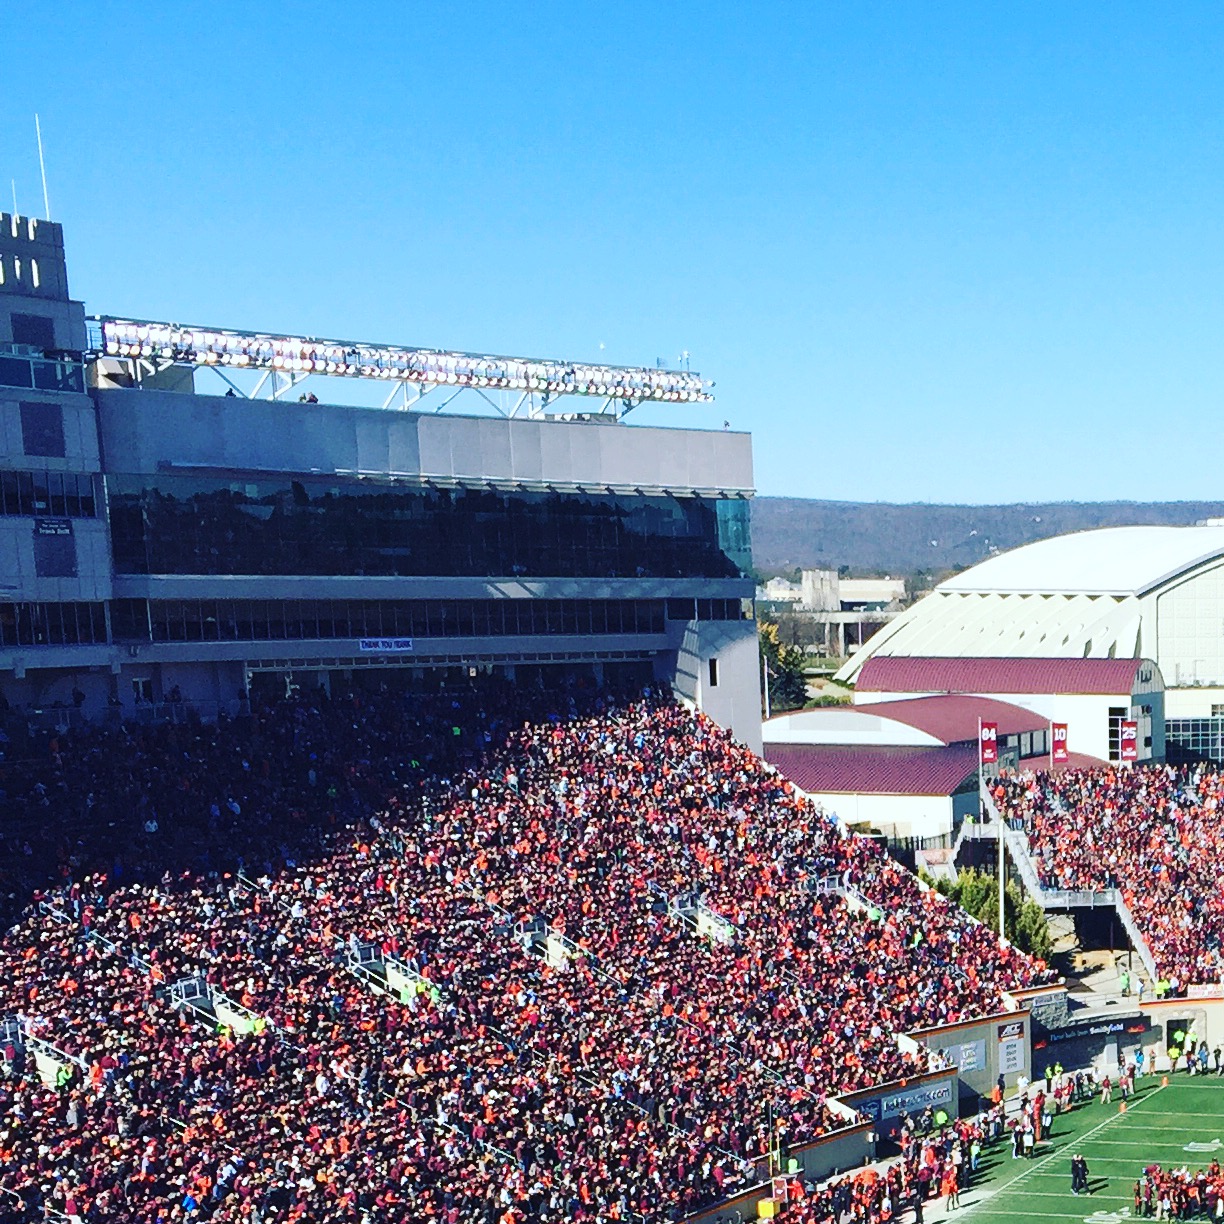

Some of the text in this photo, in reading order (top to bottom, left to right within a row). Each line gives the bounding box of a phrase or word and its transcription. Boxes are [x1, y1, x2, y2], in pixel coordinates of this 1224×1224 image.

[981, 728, 997, 741] 84
[1054, 728, 1066, 741] 10
[1122, 727, 1137, 740] 25
[1001, 1023, 1021, 1037] ACC
[1089, 1023, 1124, 1034] Smithfield
